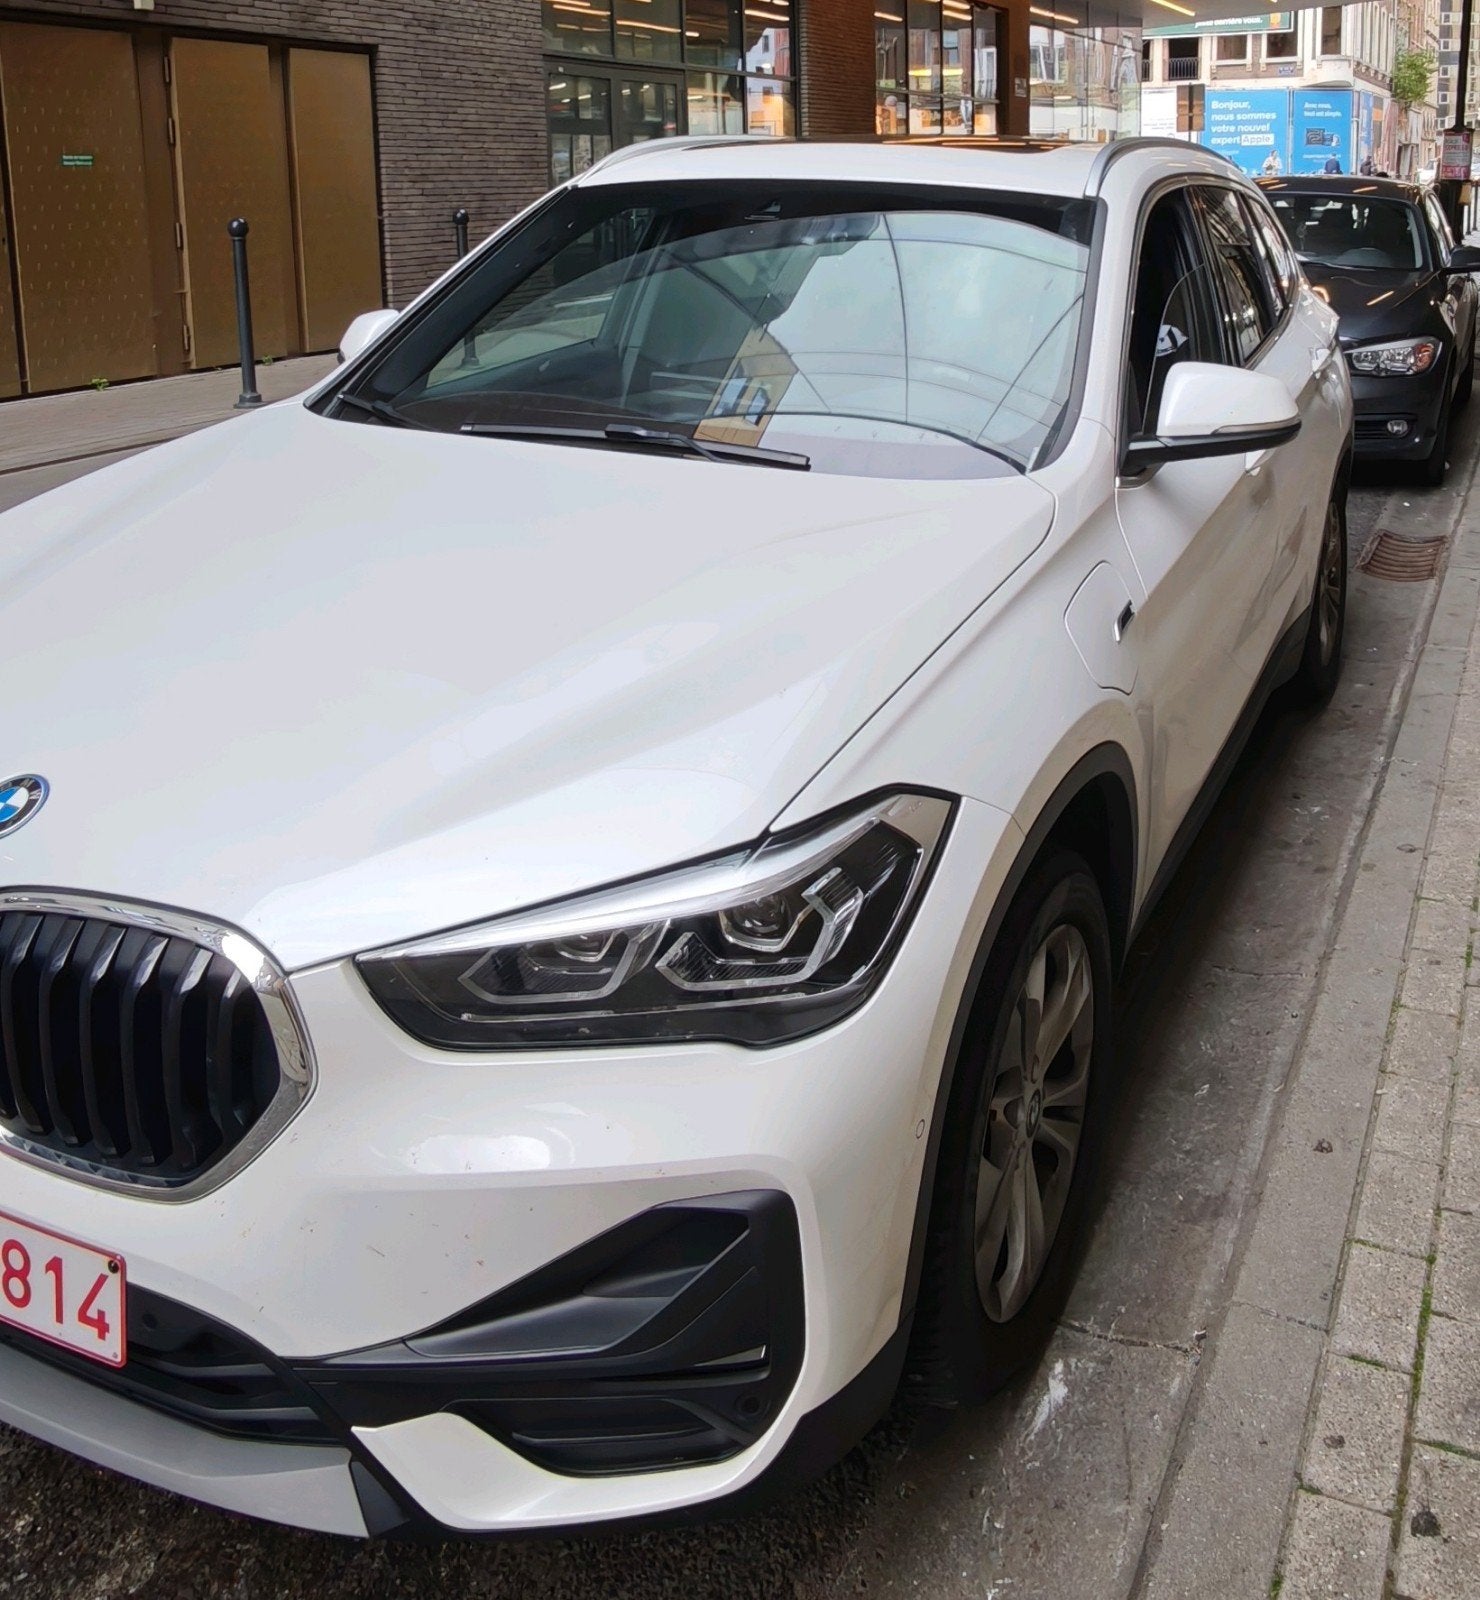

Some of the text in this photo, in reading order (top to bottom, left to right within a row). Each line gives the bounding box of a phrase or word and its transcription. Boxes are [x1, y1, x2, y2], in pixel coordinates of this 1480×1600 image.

[1211, 100, 1251, 110] Bonjour,
[1211, 112, 1276, 121] nous sommes
[1211, 122, 1271, 133] votre nouvel
[1211, 136, 1241, 145] expert
[2, 1238, 110, 1341] 814
